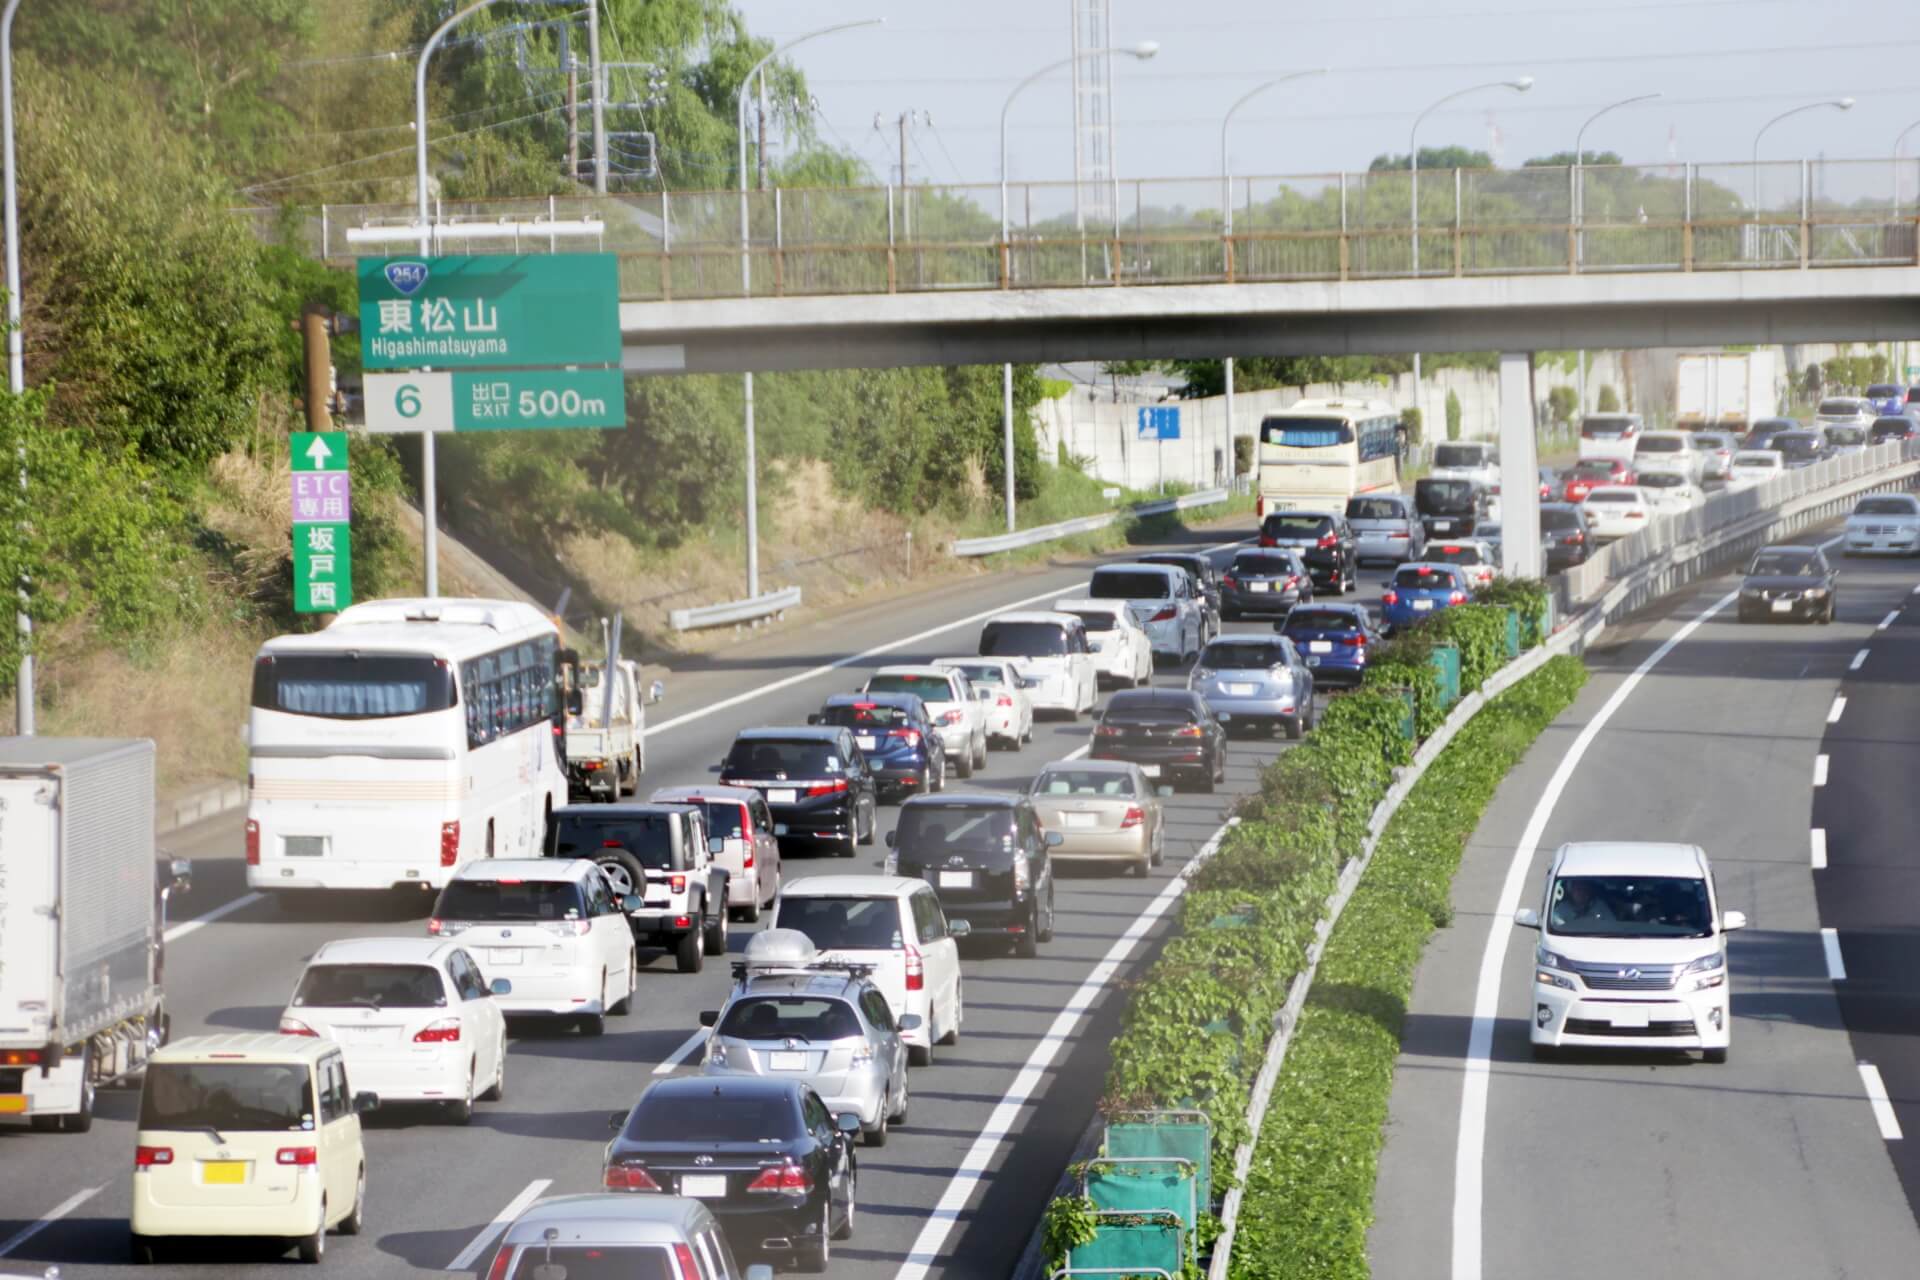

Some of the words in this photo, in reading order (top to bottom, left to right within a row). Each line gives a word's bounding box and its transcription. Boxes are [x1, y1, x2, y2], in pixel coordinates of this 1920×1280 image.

[392, 267, 421, 282] 254
[378, 297, 497, 334] 東松山
[371, 337, 507, 358] Higashimatsuyama
[394, 384, 422, 418] 6
[472, 382, 510, 401] 出口
[472, 403, 510, 417] EXIT
[518, 389, 606, 417] 500m
[297, 476, 342, 495] ETC
[298, 497, 344, 516] 専用
[308, 527, 336, 608] 坂戸西
